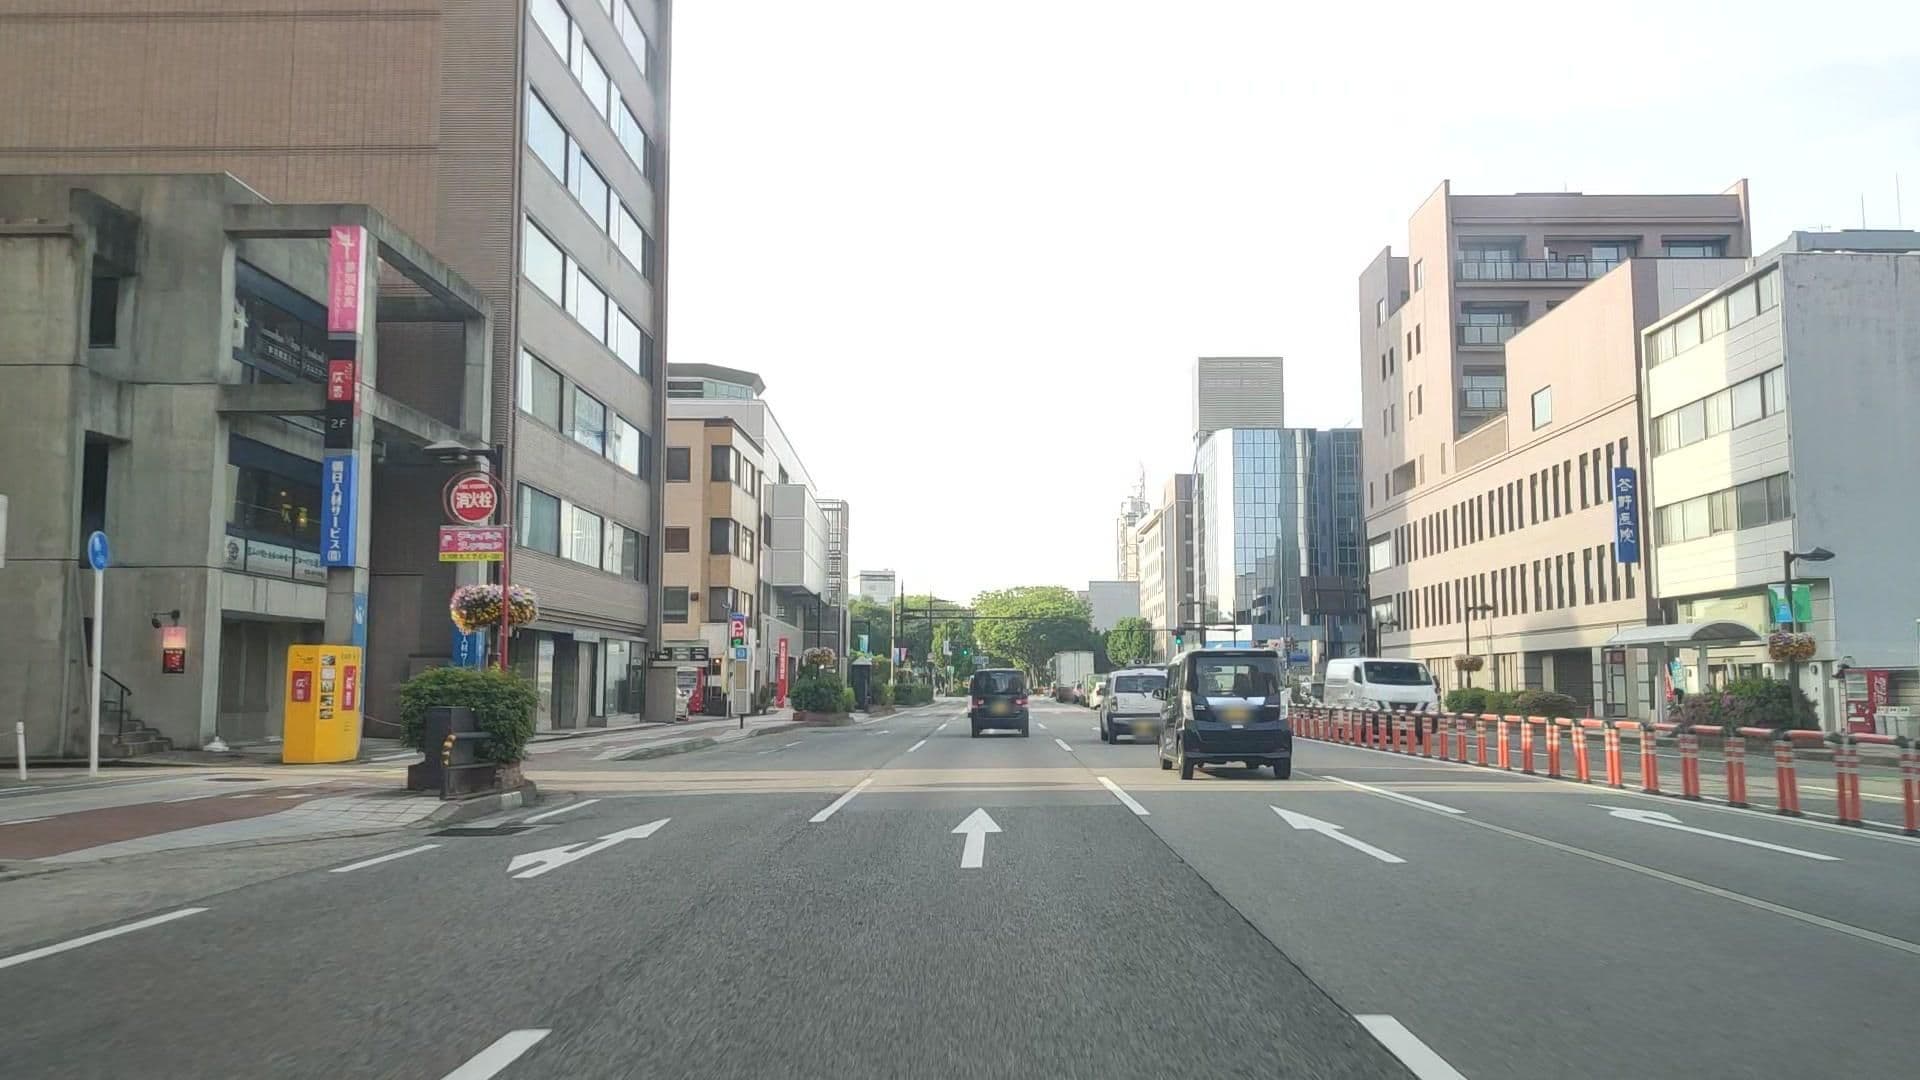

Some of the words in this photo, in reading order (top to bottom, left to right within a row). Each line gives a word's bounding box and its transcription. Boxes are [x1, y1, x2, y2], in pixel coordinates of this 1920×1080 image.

[330, 418, 347, 429] 2F
[456, 491, 493, 510] 消火栓
